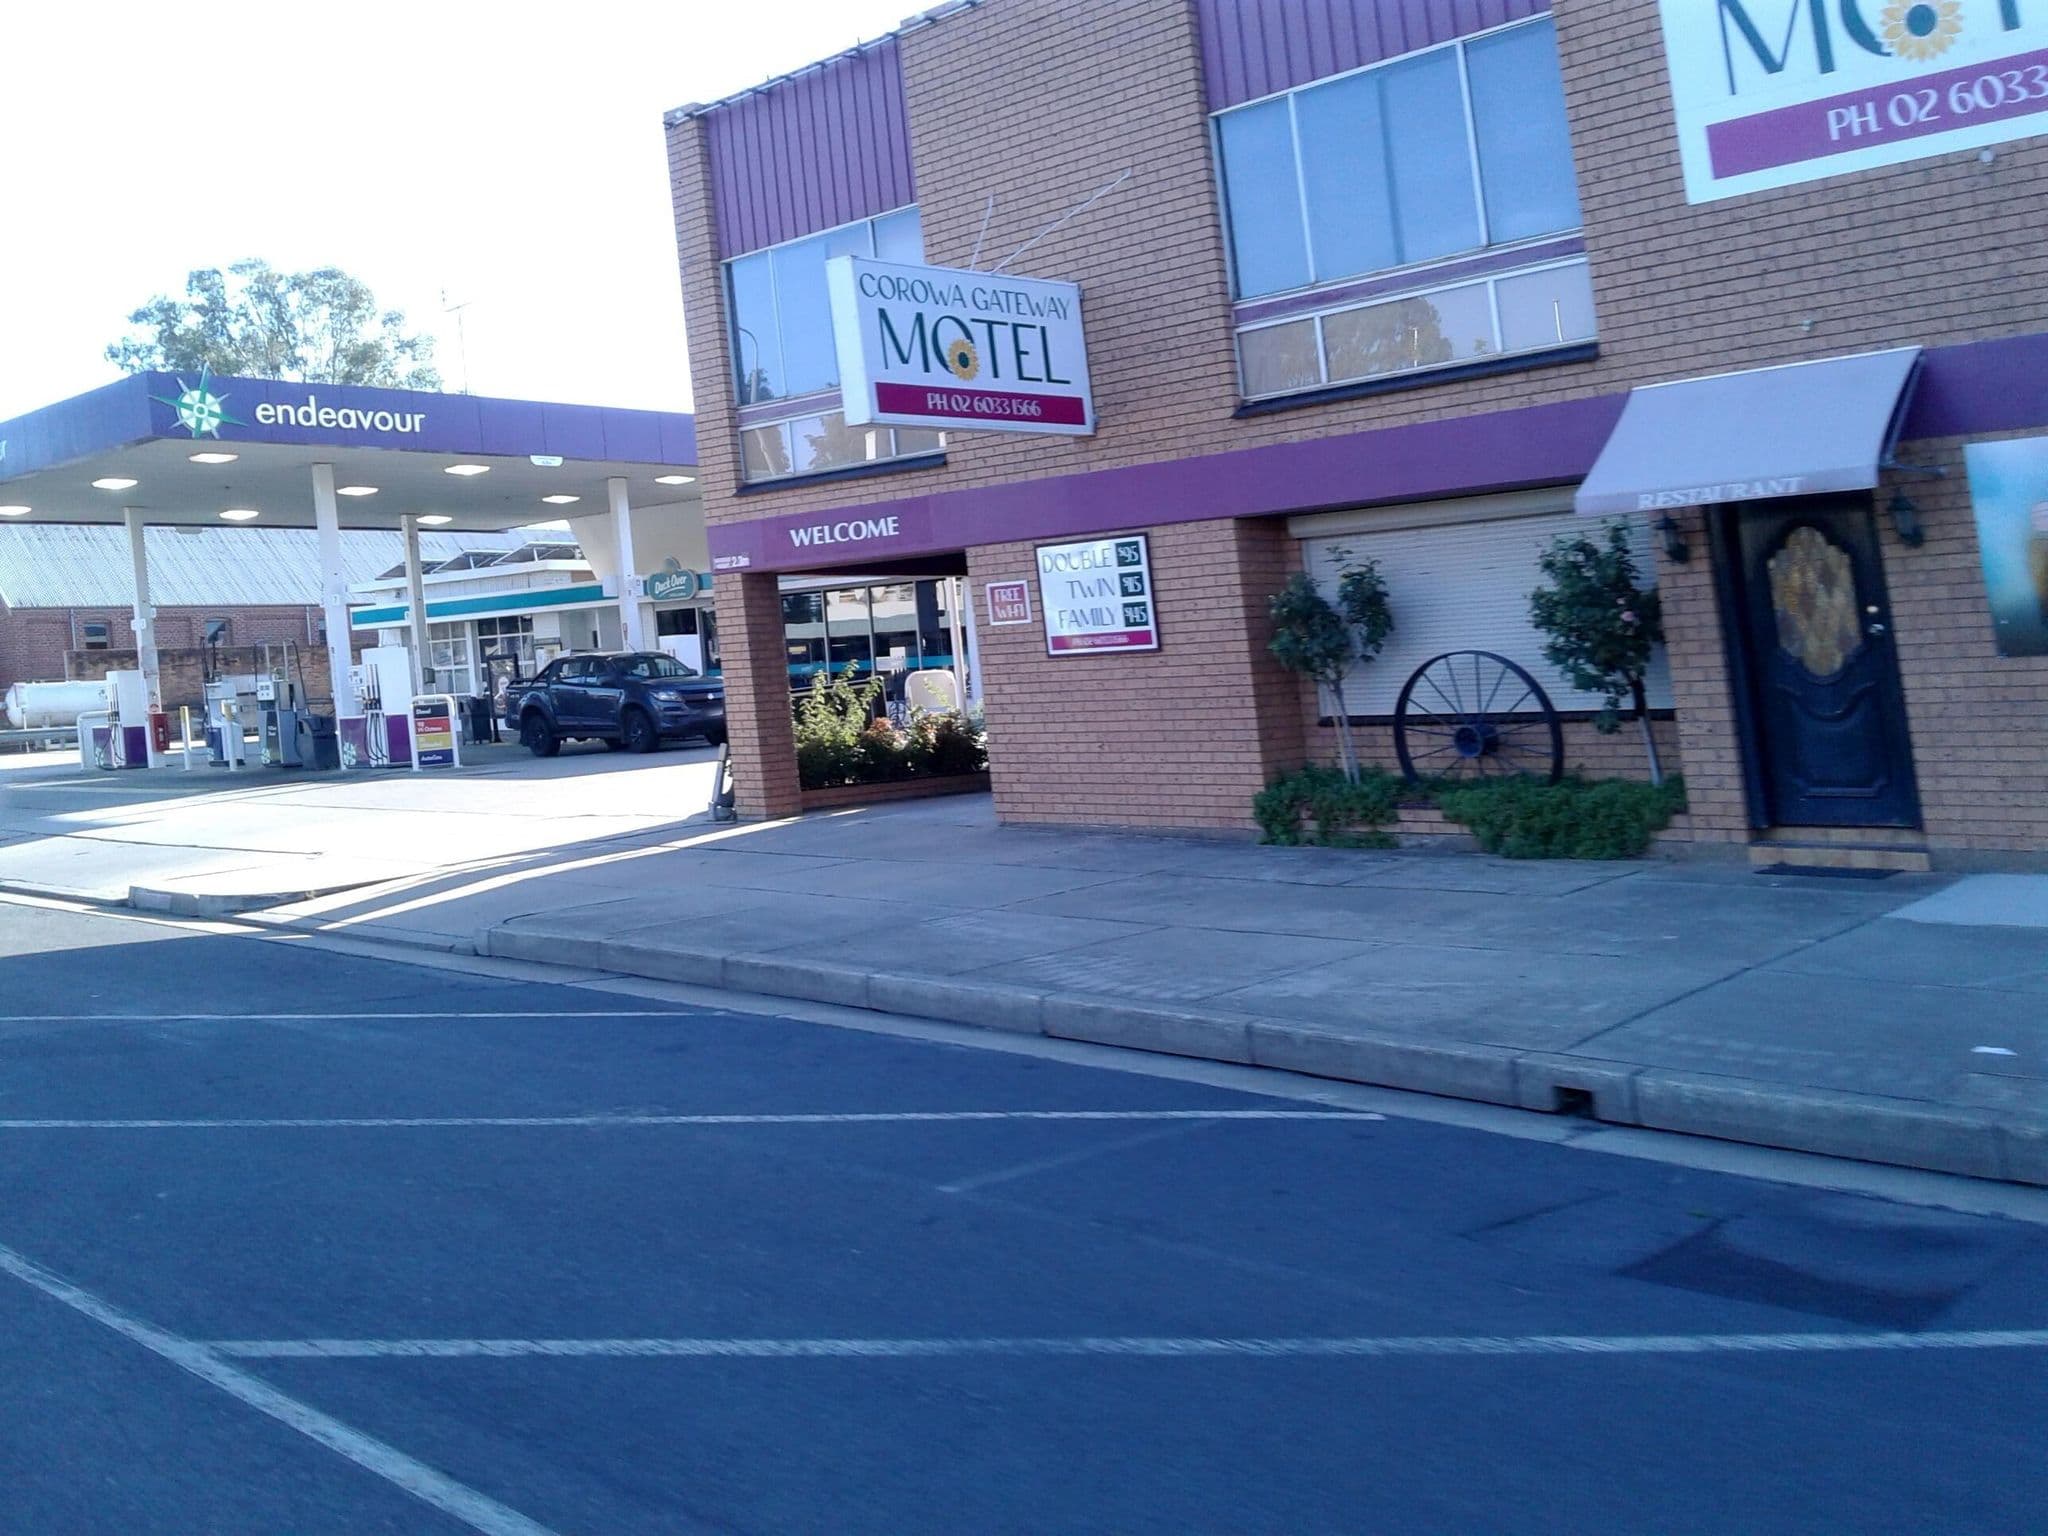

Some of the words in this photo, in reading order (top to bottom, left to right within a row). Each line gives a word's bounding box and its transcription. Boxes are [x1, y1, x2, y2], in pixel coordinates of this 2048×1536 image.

[1887, 89, 1941, 127] 02
[1949, 65, 2048, 113] 6033
[859, 272, 967, 308] COROWA
[972, 286, 1070, 321] GATEWAY
[878, 307, 1071, 385] MOTEL
[255, 395, 426, 433] endeavour
[951, 394, 971, 413] 02
[973, 395, 1010, 415] 6033
[1012, 398, 1041, 417] 1566
[1637, 477, 1805, 509] RESTAURANT
[789, 516, 900, 547] WELCOME
[1041, 548, 1113, 574] DOUBLE
[994, 587, 1023, 602] FREE
[1065, 577, 1116, 600] TWIN
[1058, 606, 1118, 629] FAMILY
